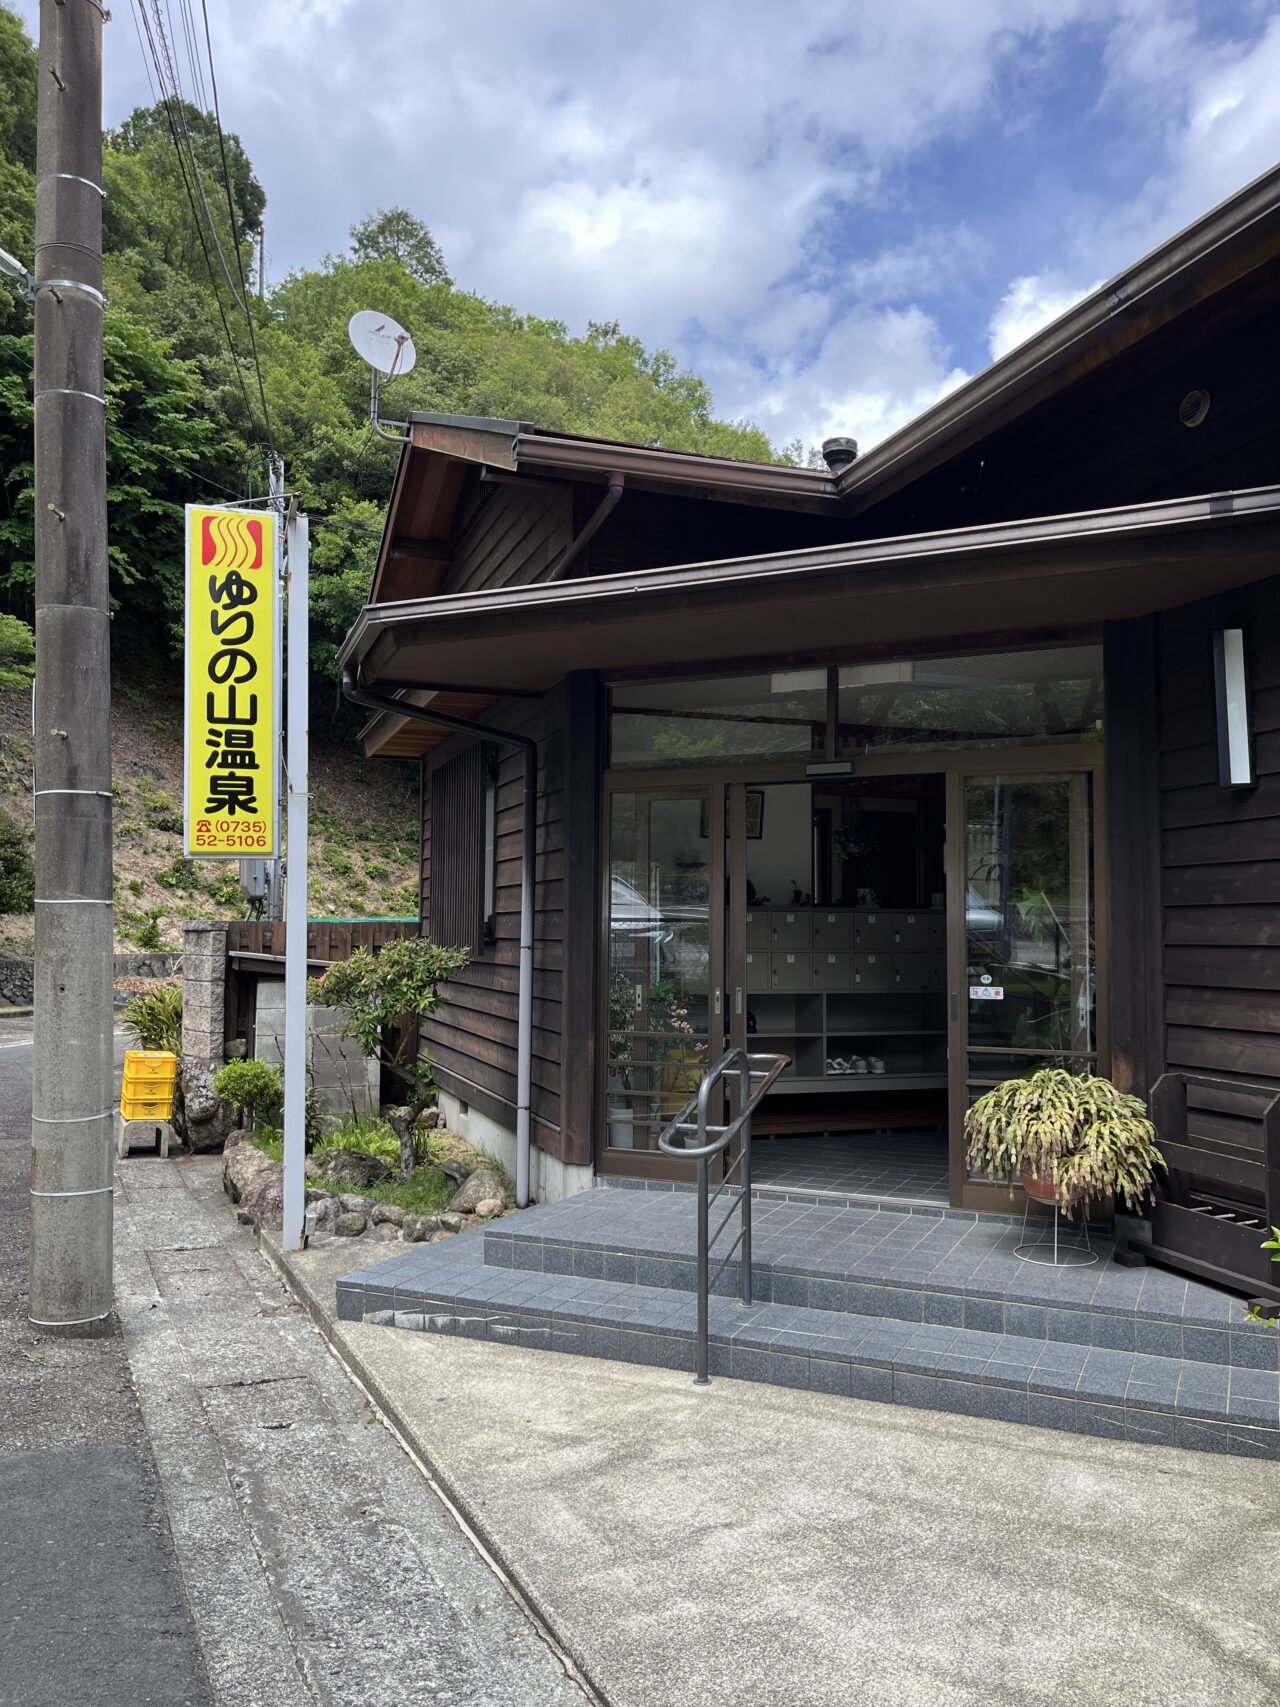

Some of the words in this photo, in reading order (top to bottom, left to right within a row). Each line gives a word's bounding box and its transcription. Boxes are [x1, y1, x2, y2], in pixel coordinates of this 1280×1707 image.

[204, 570, 260, 816] ゆりの山温泉
[216, 820, 267, 833] (0735)
[196, 835, 267, 847] 52-5106
